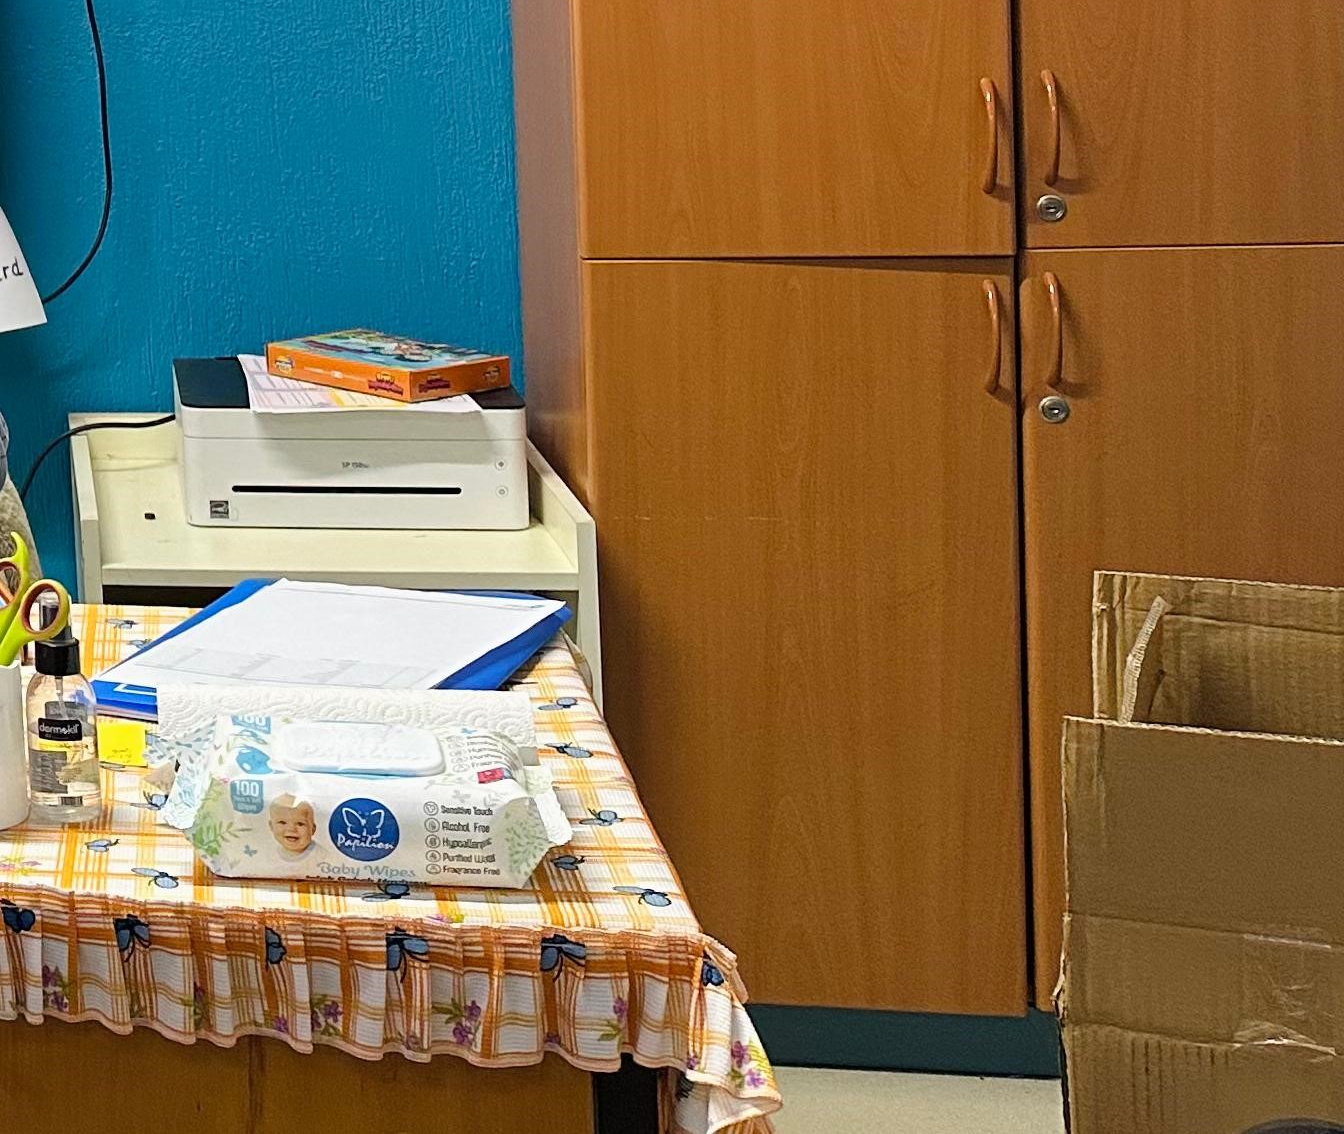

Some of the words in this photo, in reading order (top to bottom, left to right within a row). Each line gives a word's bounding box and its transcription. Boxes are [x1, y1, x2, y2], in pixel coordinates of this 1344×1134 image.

[235, 780, 260, 797] 100
[441, 821, 470, 833] Alcohol
[473, 822, 491, 833] Free
[316, 861, 360, 878] Baby
[363, 863, 417, 879] Wipes
[442, 865, 482, 875] Fragrance
